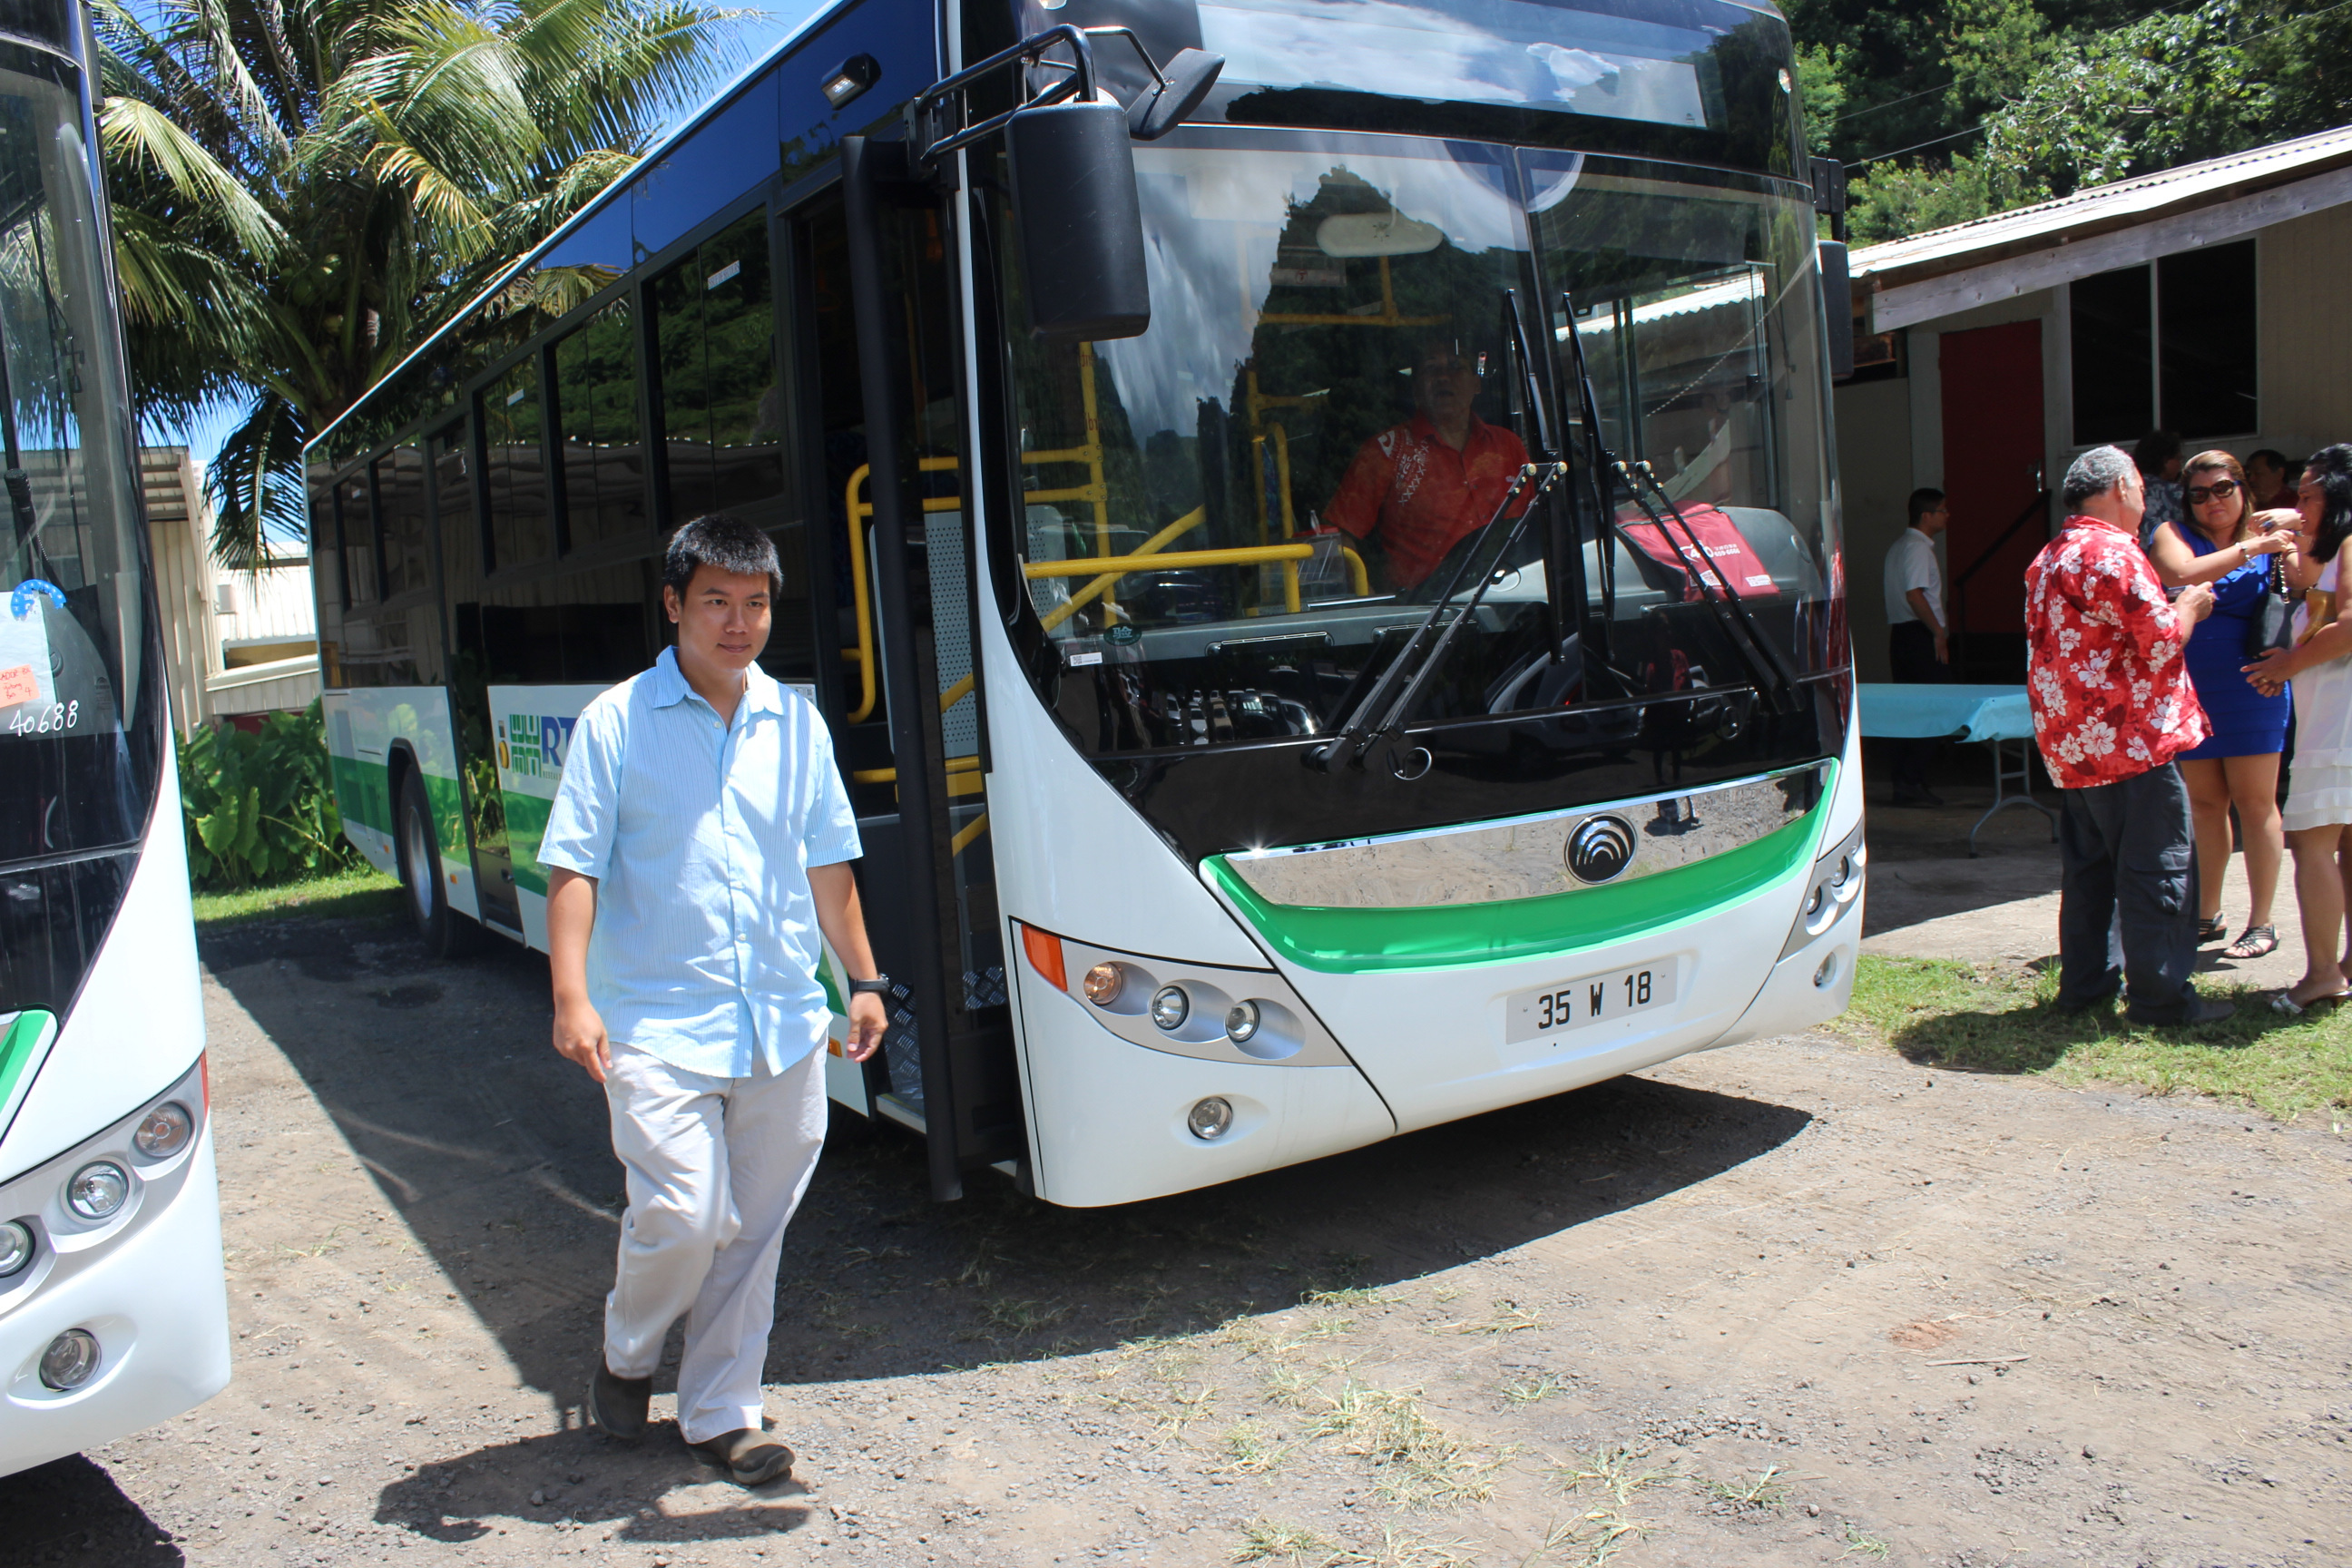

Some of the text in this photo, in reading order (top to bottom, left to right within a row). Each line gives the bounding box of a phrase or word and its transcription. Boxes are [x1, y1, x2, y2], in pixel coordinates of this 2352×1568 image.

[9, 700, 79, 737] 40688
[1538, 971, 1652, 1030] 35 W 18
